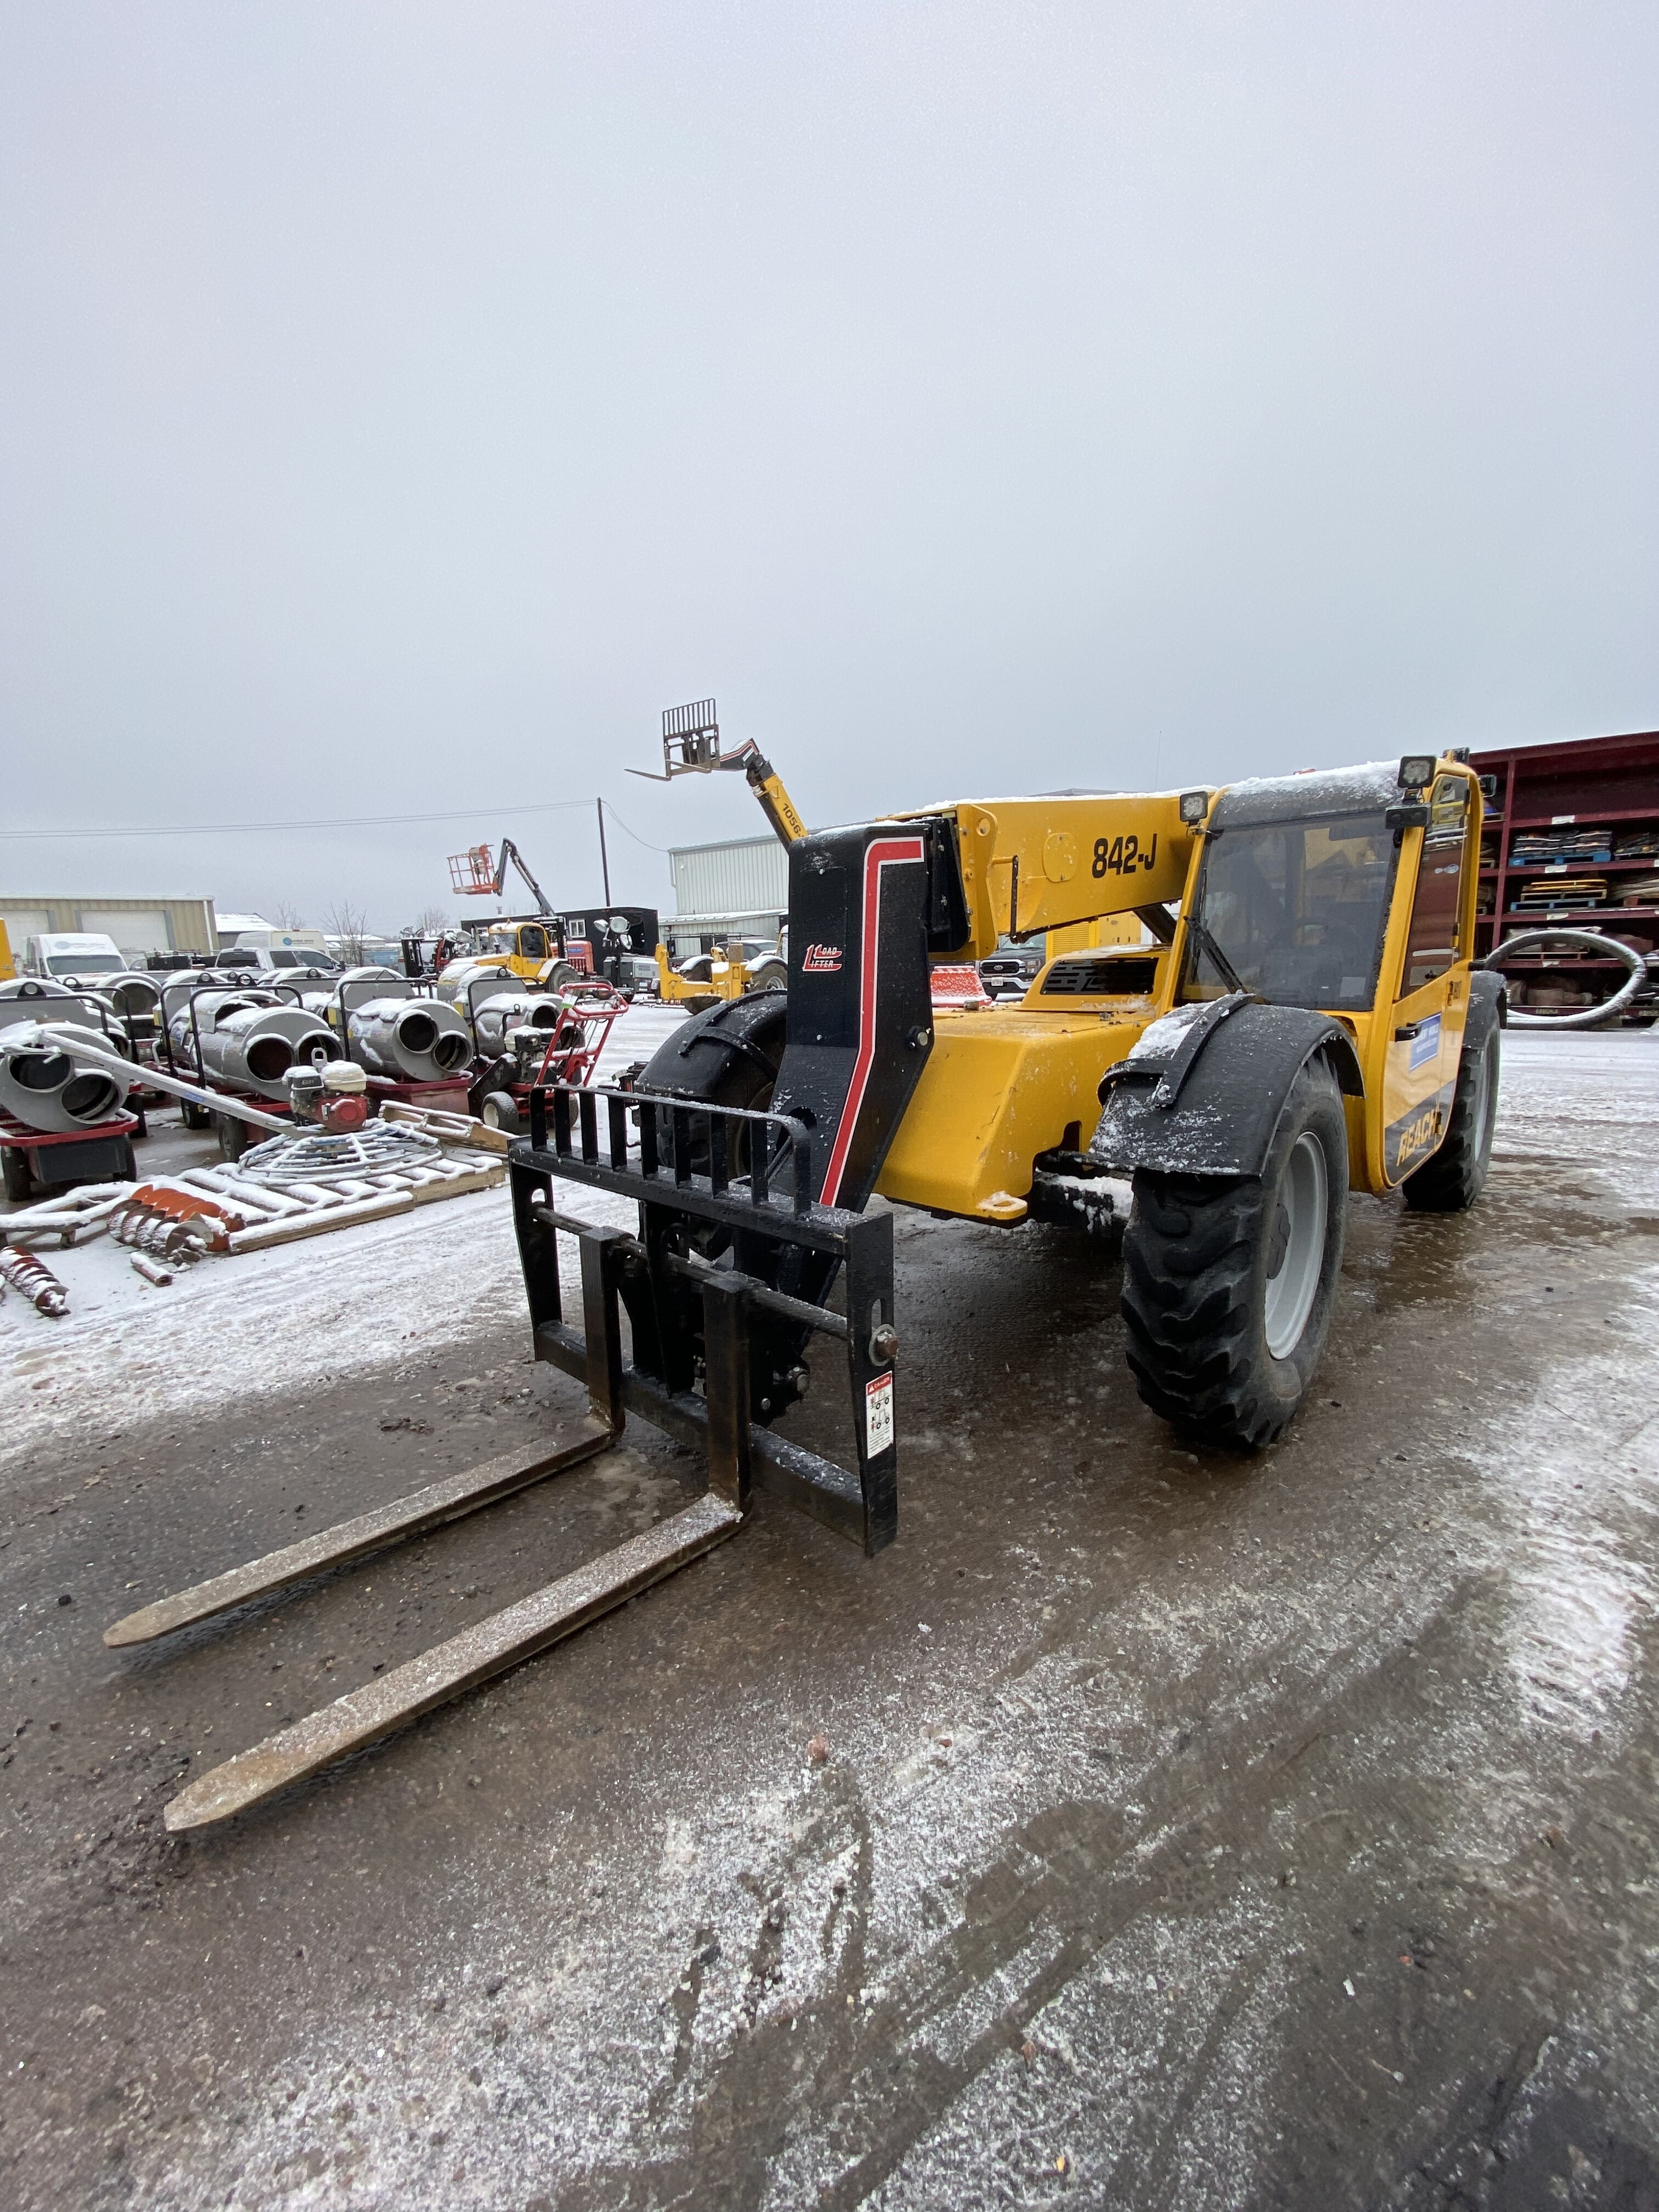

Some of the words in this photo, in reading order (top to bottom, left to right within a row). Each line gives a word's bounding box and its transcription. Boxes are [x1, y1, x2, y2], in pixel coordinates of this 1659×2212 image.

[1092, 833, 1158, 879] 842-J
[802, 944, 842, 972] LIFTER
[813, 944, 843, 959] LOAD
[1396, 1108, 1438, 1167] REACH
